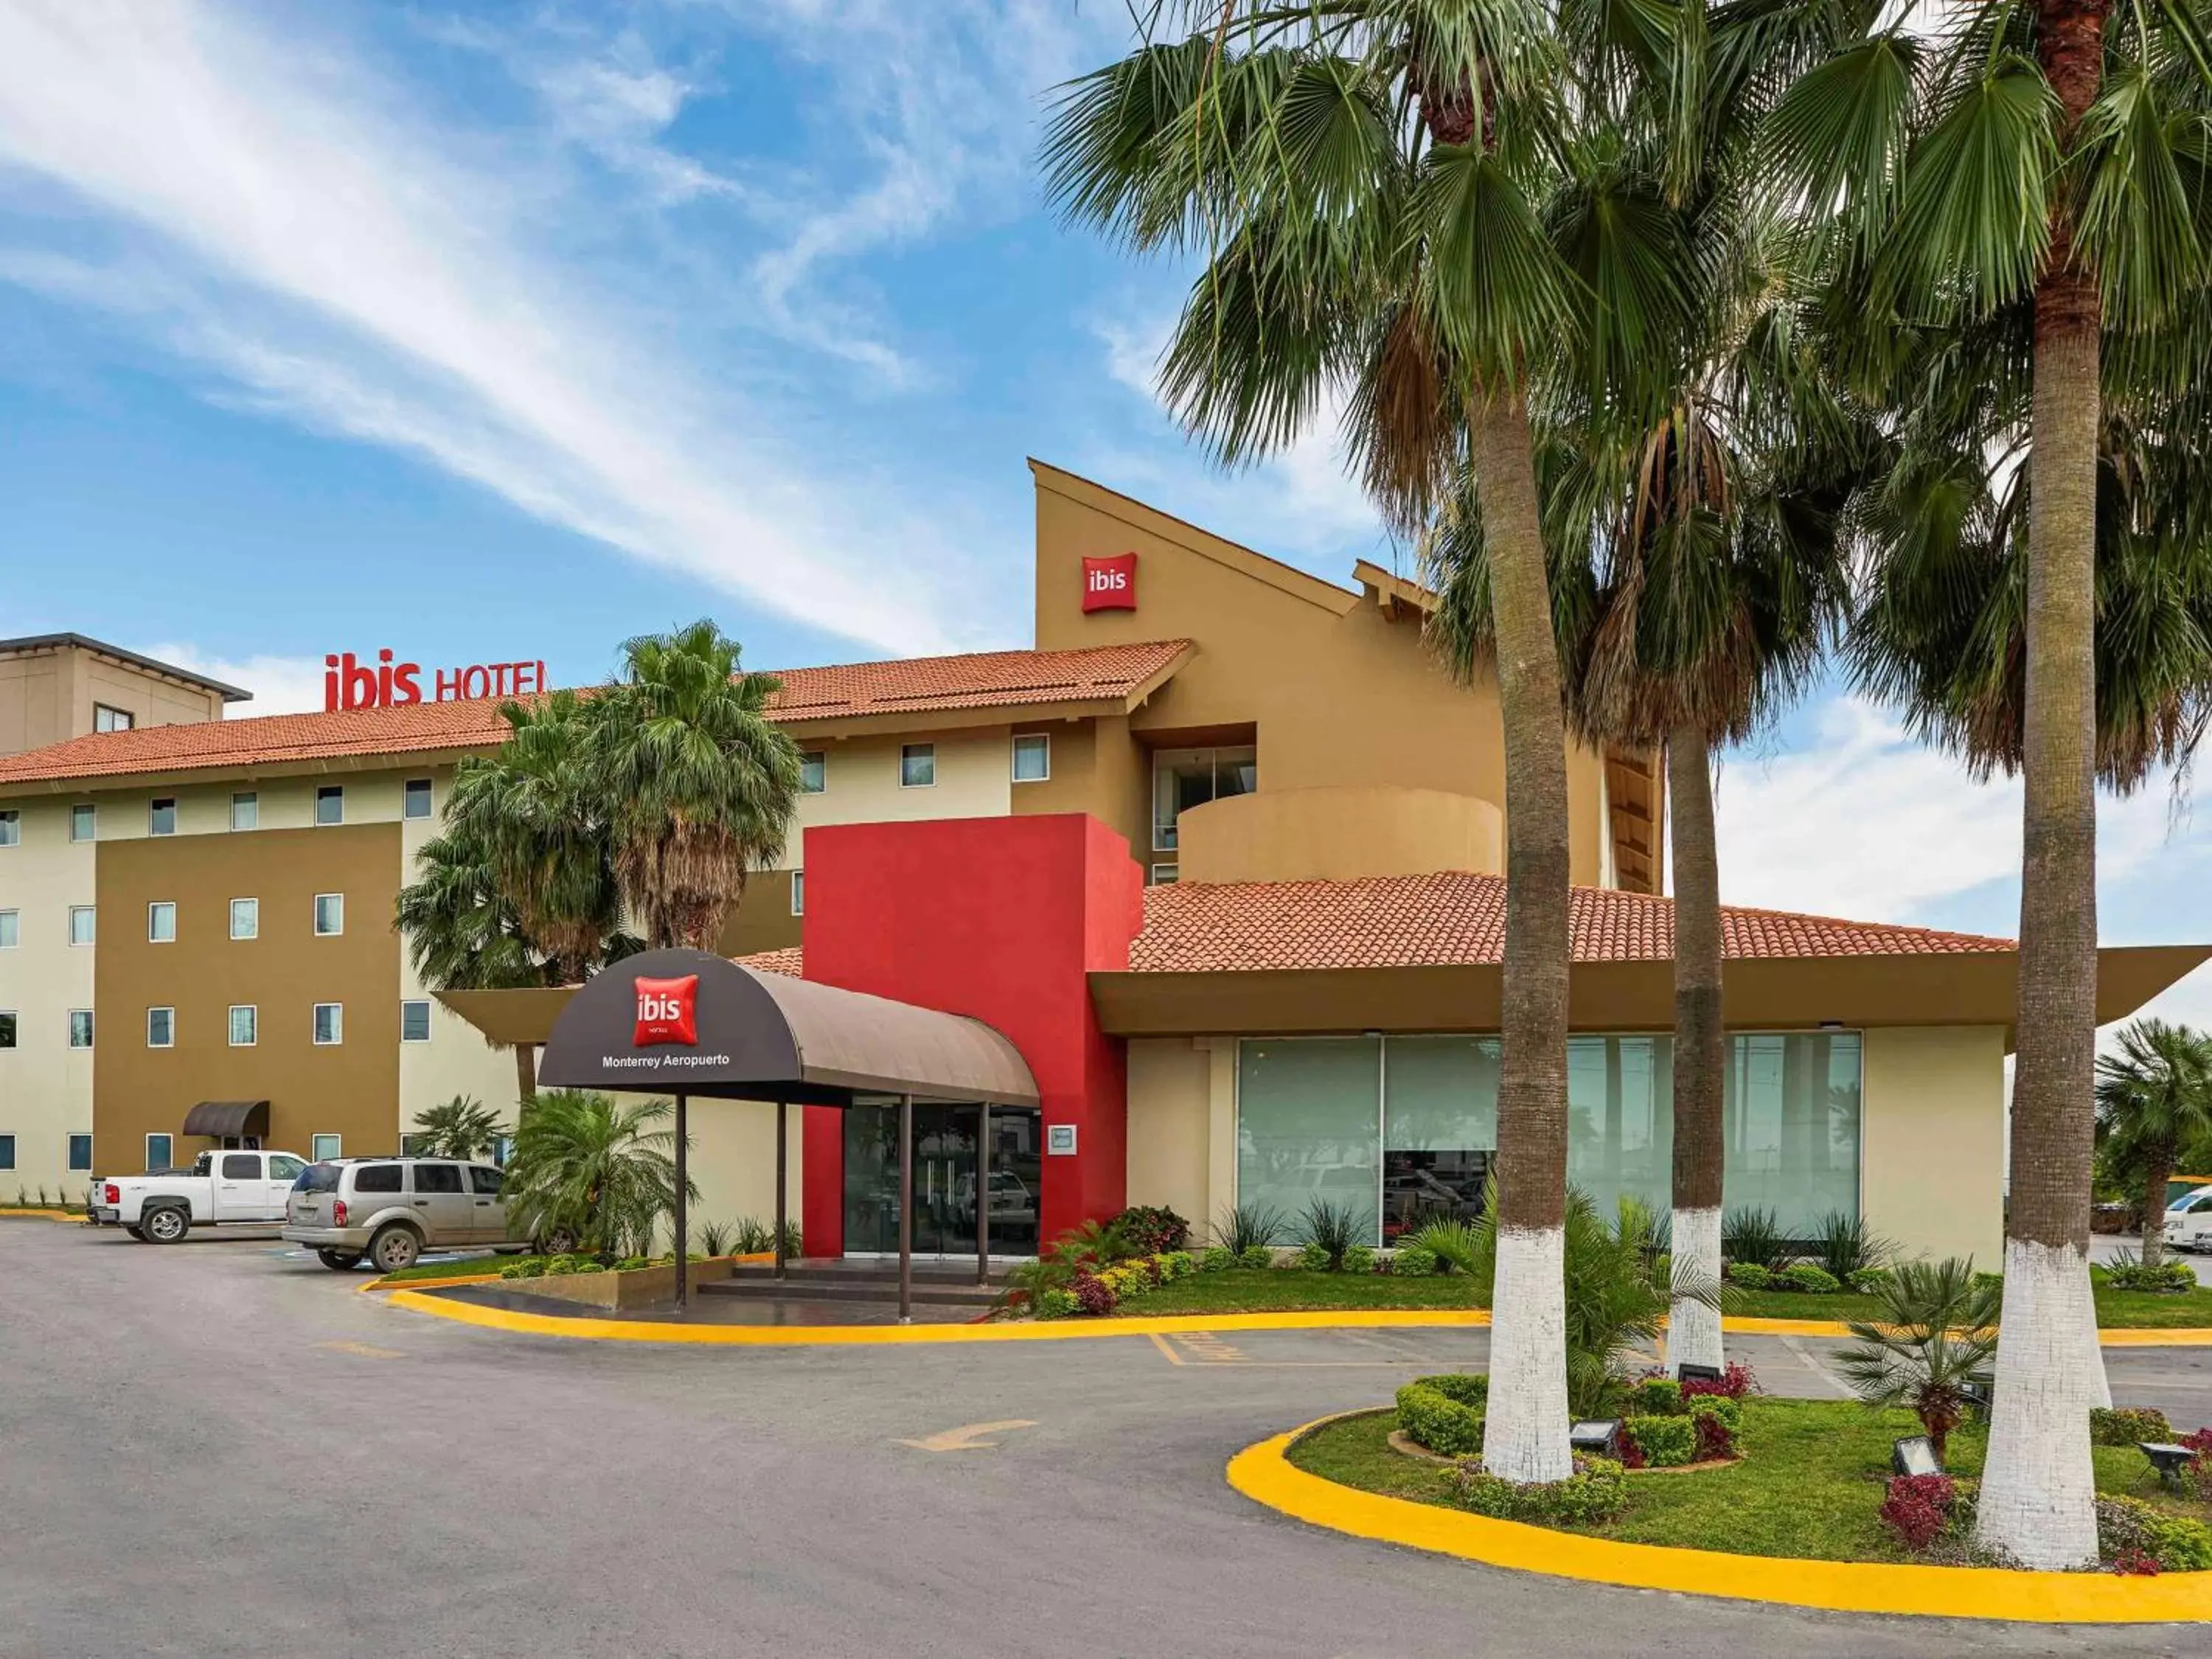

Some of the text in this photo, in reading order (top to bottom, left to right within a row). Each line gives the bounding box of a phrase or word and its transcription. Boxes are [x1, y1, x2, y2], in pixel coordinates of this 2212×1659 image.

[1090, 568, 1126, 591] ibis
[325, 649, 421, 713] ibis
[638, 993, 680, 1021] ibis
[602, 1054, 730, 1069] Monterrey Aeropuerto
